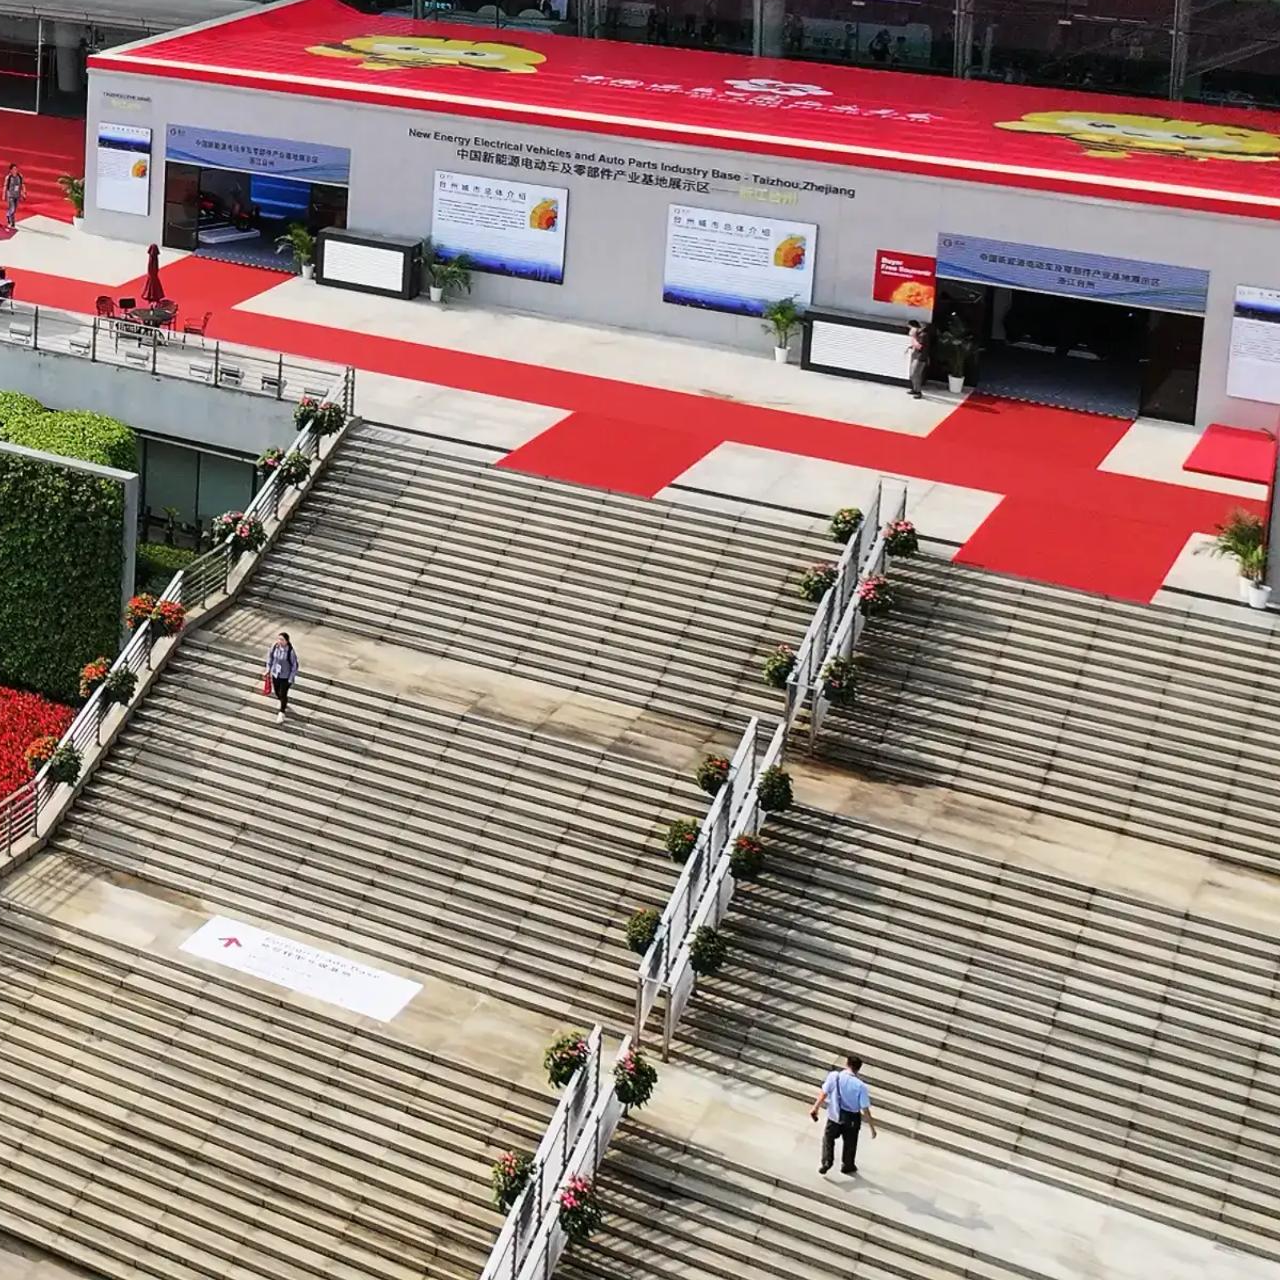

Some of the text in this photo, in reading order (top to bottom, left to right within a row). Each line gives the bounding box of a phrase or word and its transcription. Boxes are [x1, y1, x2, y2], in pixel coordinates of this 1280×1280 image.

[408, 128, 431, 139] New
[433, 131, 471, 147] Energy
[474, 136, 523, 152] Electrical
[525, 144, 571, 159] Vehicles
[574, 151, 596, 162] and
[598, 154, 625, 166] Auto
[628, 158, 658, 170] Parts
[660, 162, 708, 179] Industry
[711, 169, 741, 182] Base
